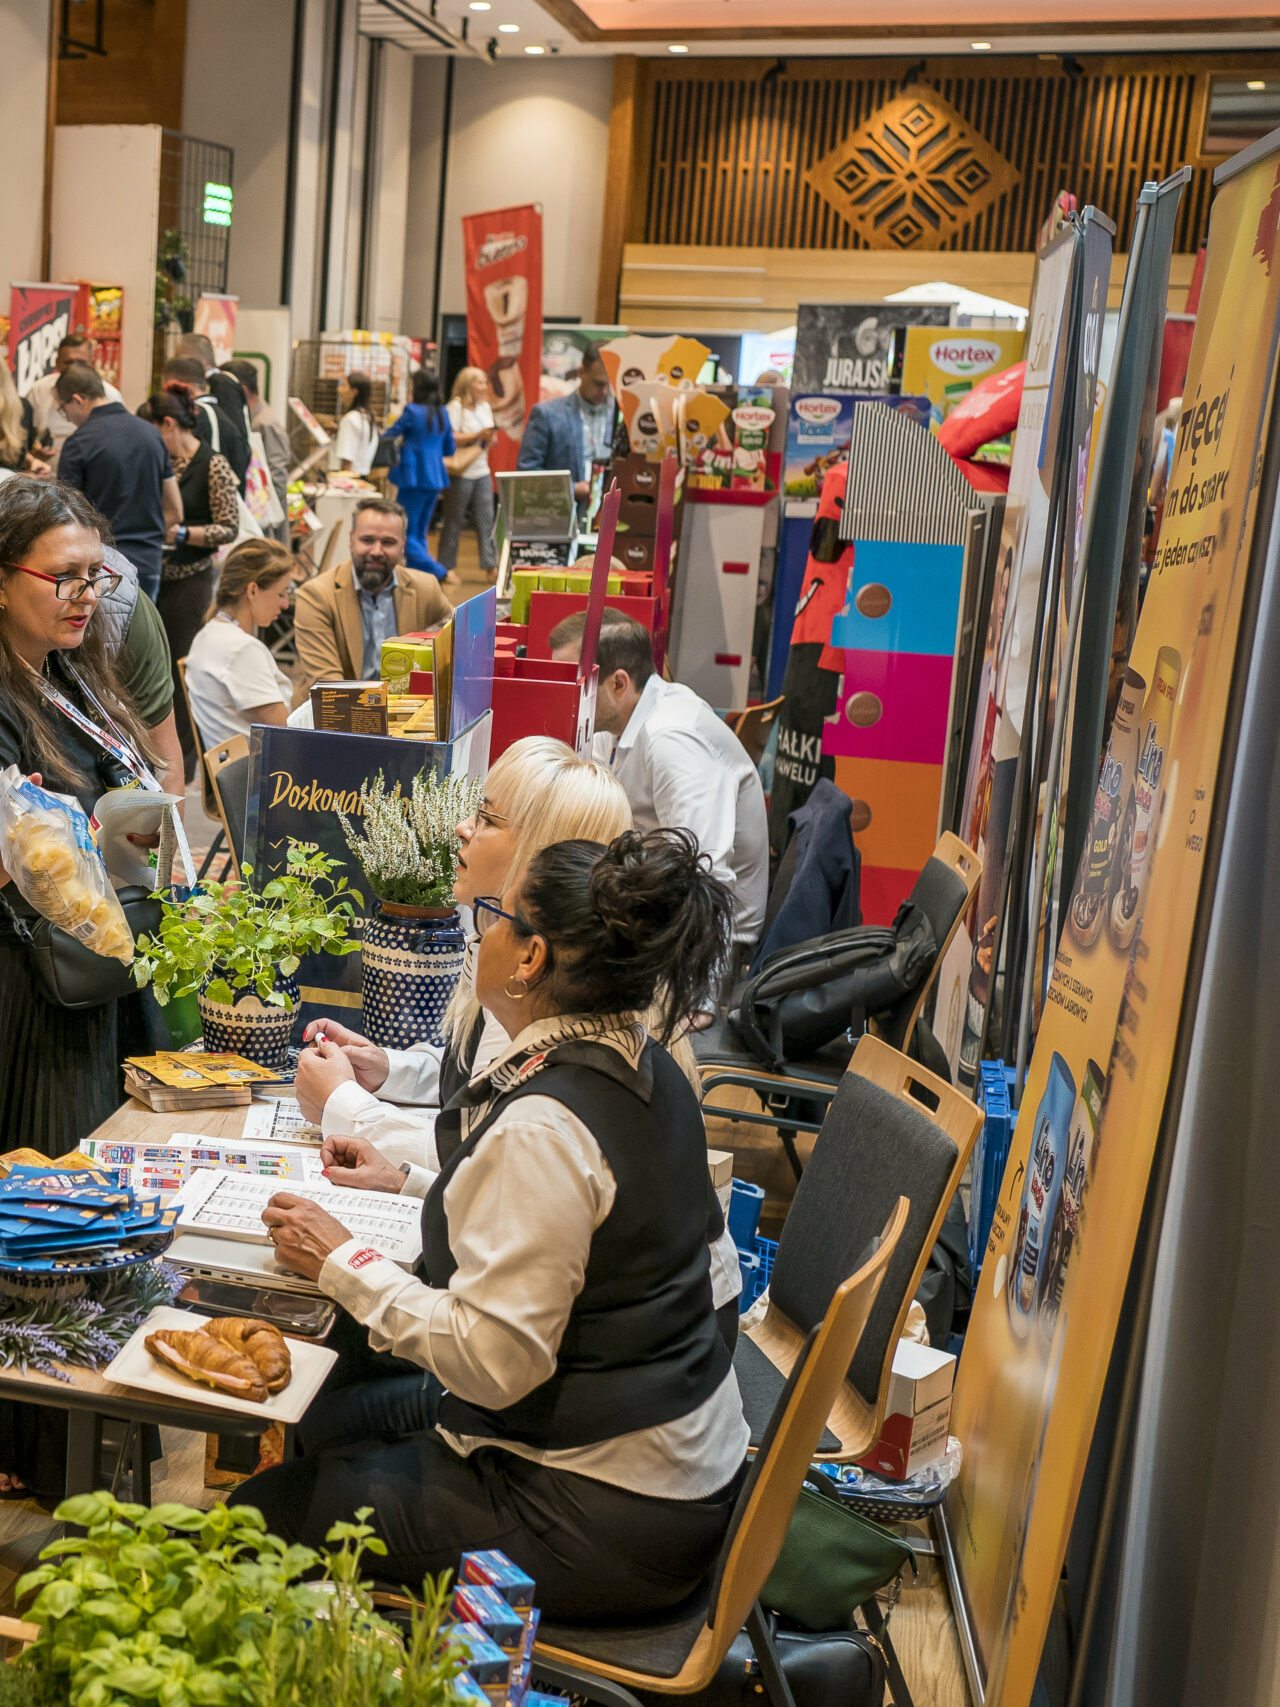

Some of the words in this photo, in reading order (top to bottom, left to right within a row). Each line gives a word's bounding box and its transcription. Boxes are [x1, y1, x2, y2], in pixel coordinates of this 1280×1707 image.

[934, 344, 996, 363] Hortex
[1179, 472, 1199, 515] do
[1094, 839, 1108, 854] GOLD
